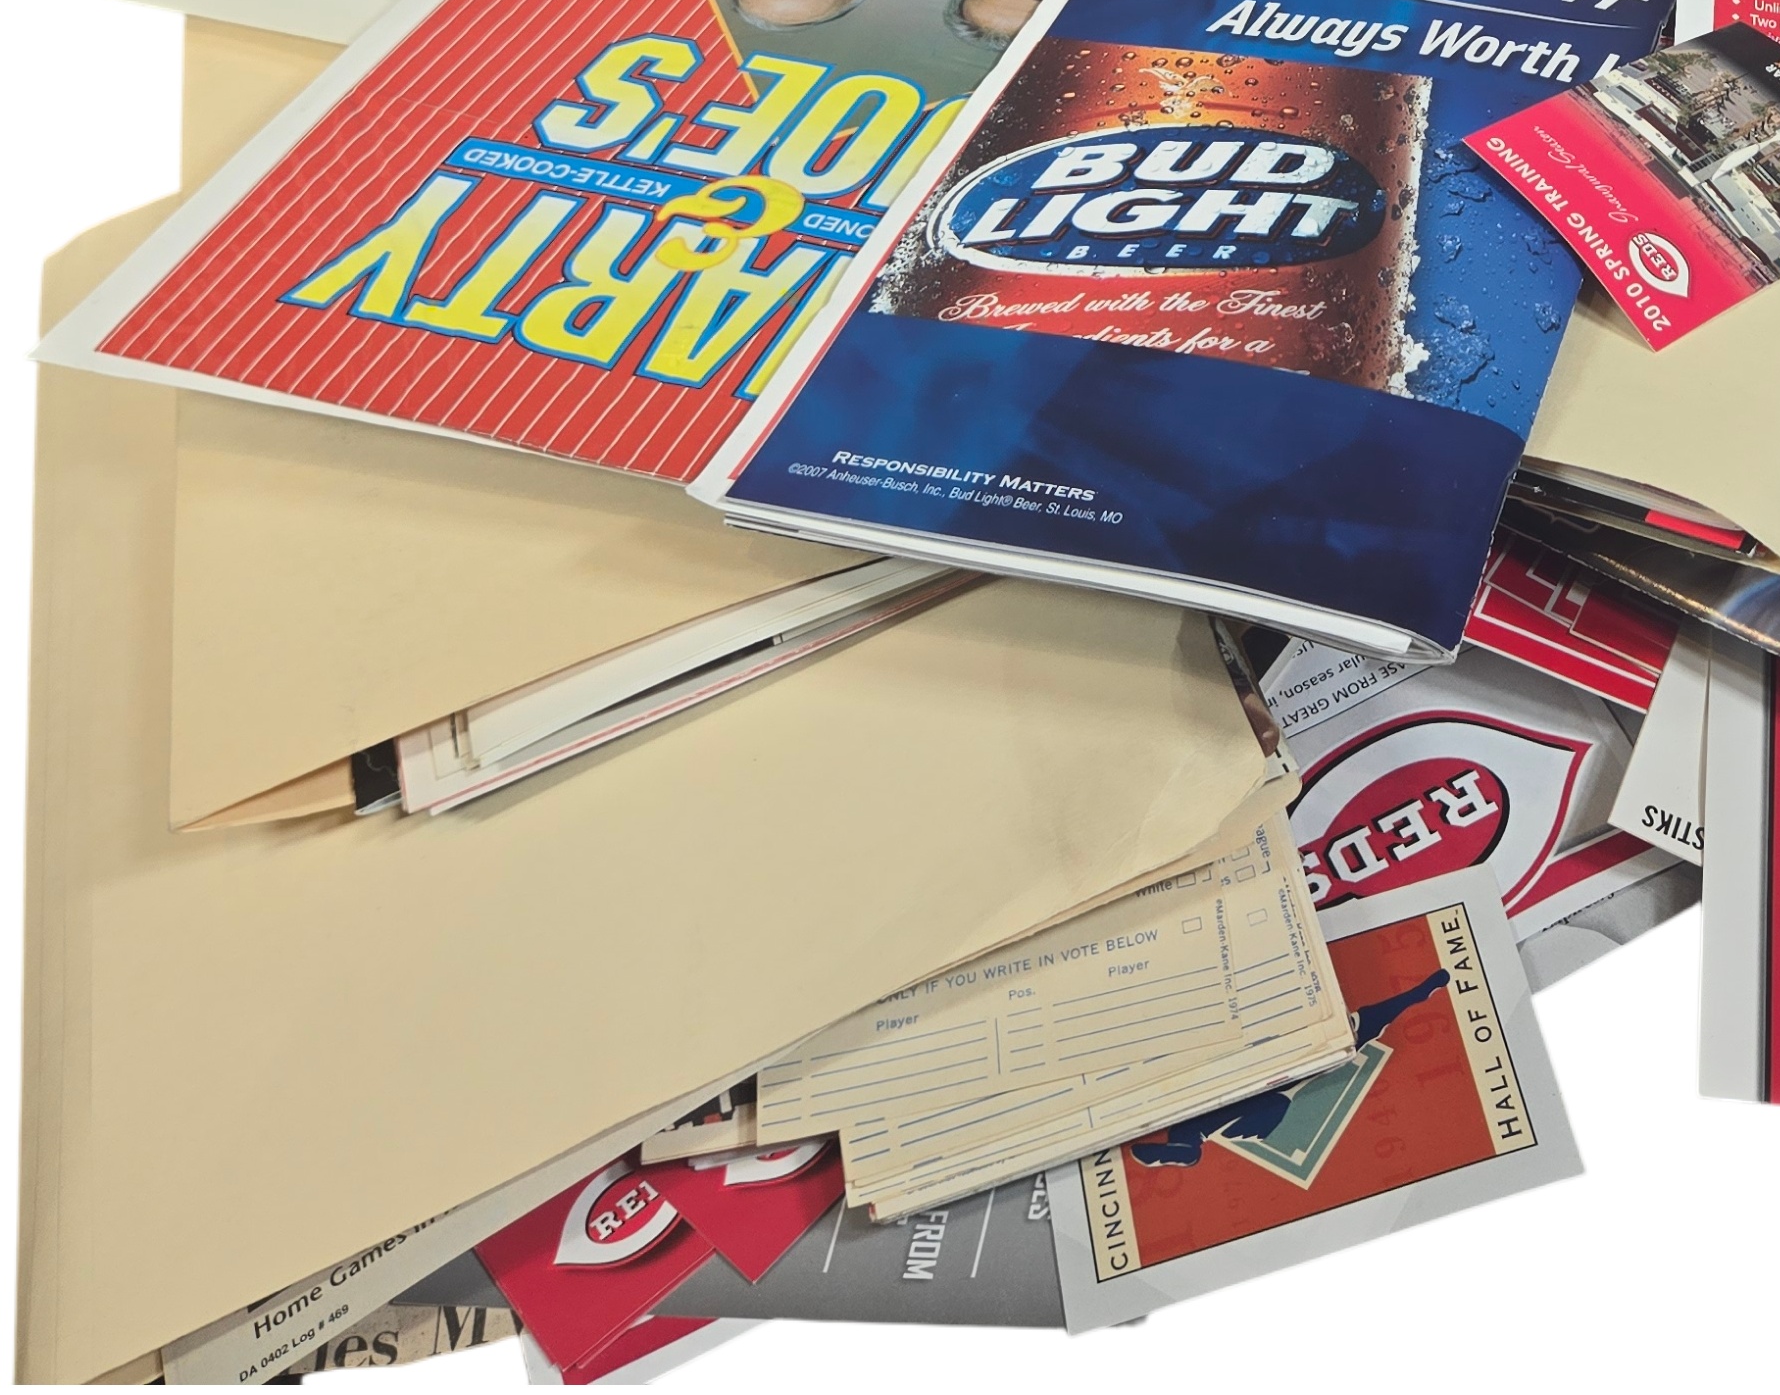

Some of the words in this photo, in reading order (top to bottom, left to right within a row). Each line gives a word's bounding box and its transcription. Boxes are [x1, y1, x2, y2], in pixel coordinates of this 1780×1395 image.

[1751, 14, 1776, 30] Two
[1419, 17, 1597, 84] Worth
[463, 148, 671, 196] KETTLE-COOKED
[1030, 142, 1334, 190] BUD
[1485, 137, 1573, 211] TRAINING
[966, 189, 1361, 248] LIGHT
[1567, 211, 1631, 285] SPRING
[939, 290, 1077, 323] Brewed
[1083, 292, 1147, 315] with
[1166, 292, 1206, 315] the
[1211, 289, 1328, 322] Finest
[1626, 280, 1673, 332] 2010
[826, 469, 920, 494] Anheuser-Busch,
[923, 482, 945, 498] Inc.,
[949, 487, 973, 501] Bud
[1014, 497, 1042, 513] Beer,
[1046, 502, 1061, 515] St.
[1063, 505, 1097, 522] Louis,
[1100, 510, 1123, 525] MO
[1301, 769, 1498, 897] REDS
[925, 979, 940, 996] IF
[944, 971, 981, 990] YOU
[985, 960, 1030, 983] WRITE
[1035, 954, 1055, 972] IN
[1060, 943, 1101, 967] VOTE
[1105, 927, 1160, 956] BELOW
[1108, 958, 1150, 980] Player
[1008, 986, 1037, 1002] Pos.
[875, 1011, 920, 1034] Player
[1474, 1008, 1498, 1046] OF
[1489, 1056, 1524, 1141] HALL
[901, 1211, 950, 1283] FROM
[254, 1287, 324, 1341] Home
[329, 1234, 408, 1287] Games
